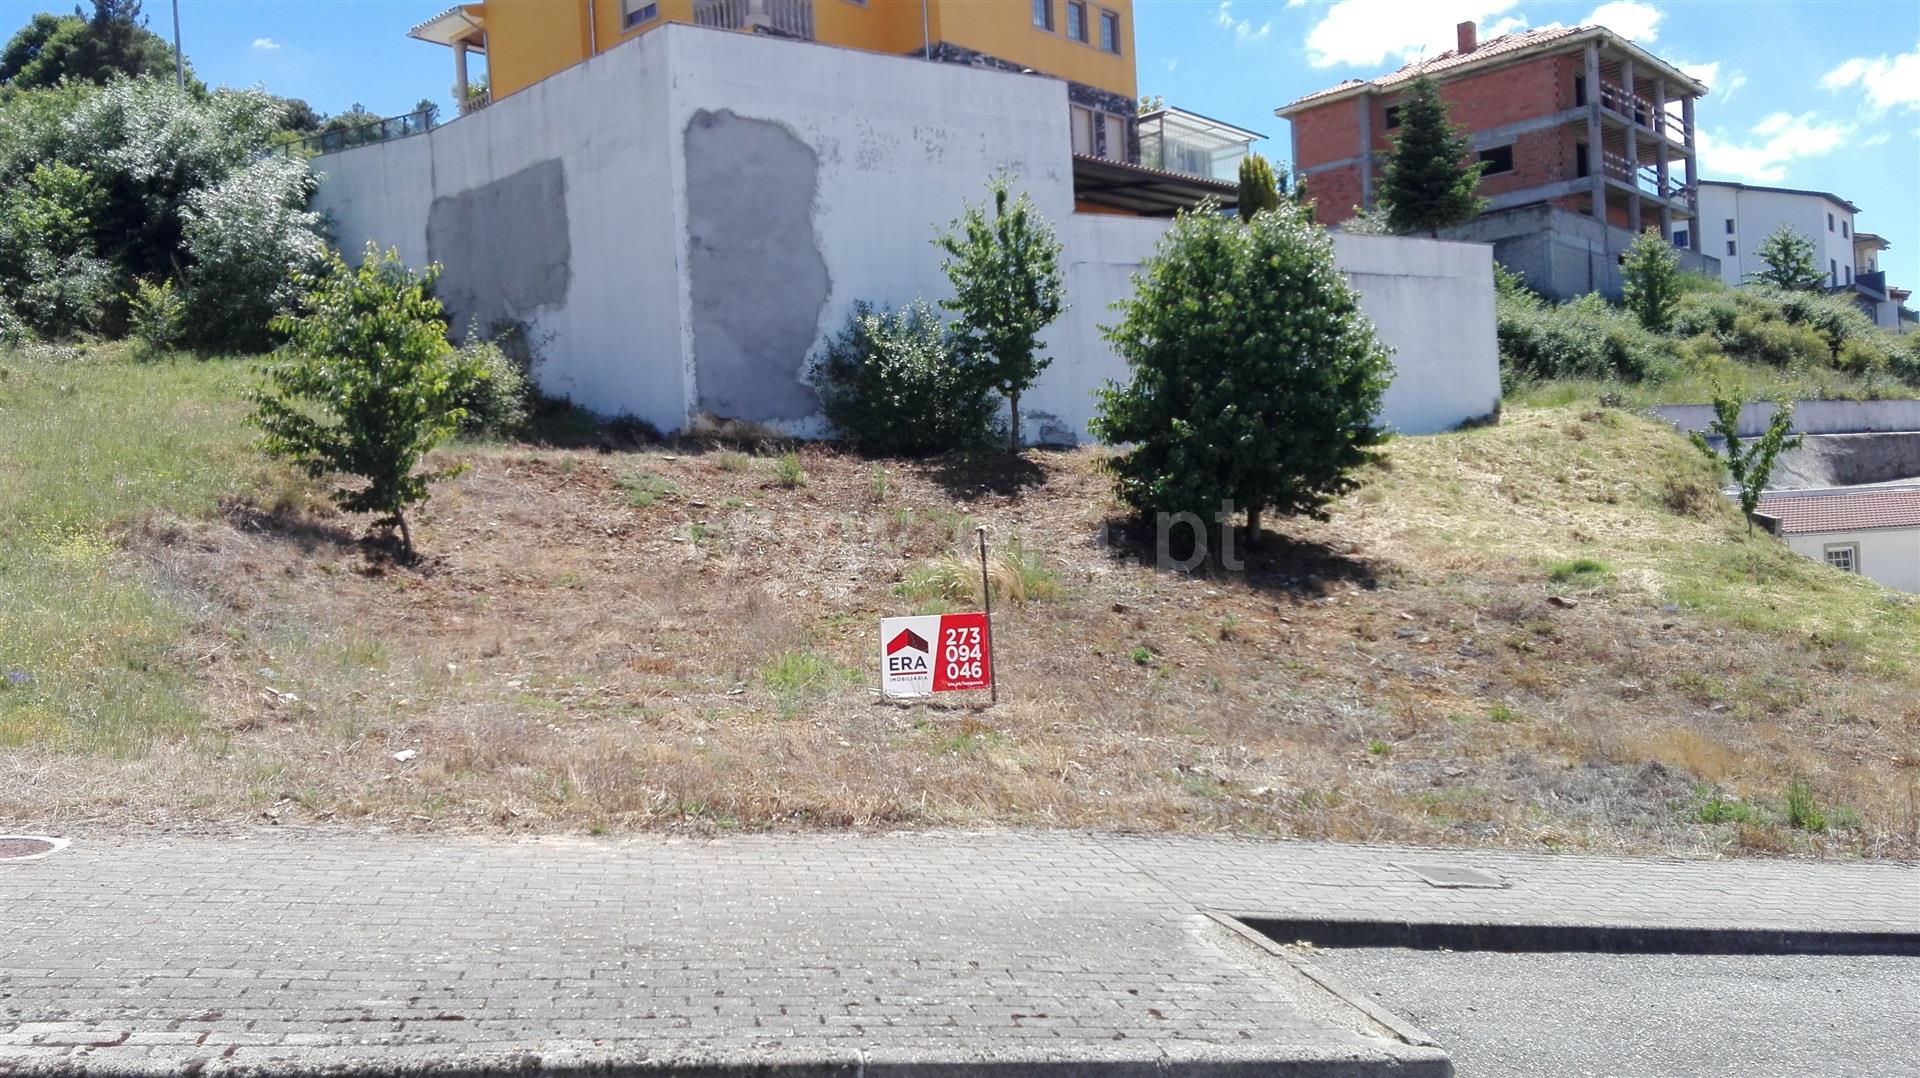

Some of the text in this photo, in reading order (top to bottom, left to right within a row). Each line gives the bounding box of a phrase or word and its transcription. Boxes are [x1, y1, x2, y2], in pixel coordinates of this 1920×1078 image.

[945, 628, 981, 646] 273
[945, 645, 982, 662] 094
[889, 656, 927, 671] ERA
[946, 662, 983, 680] 046
